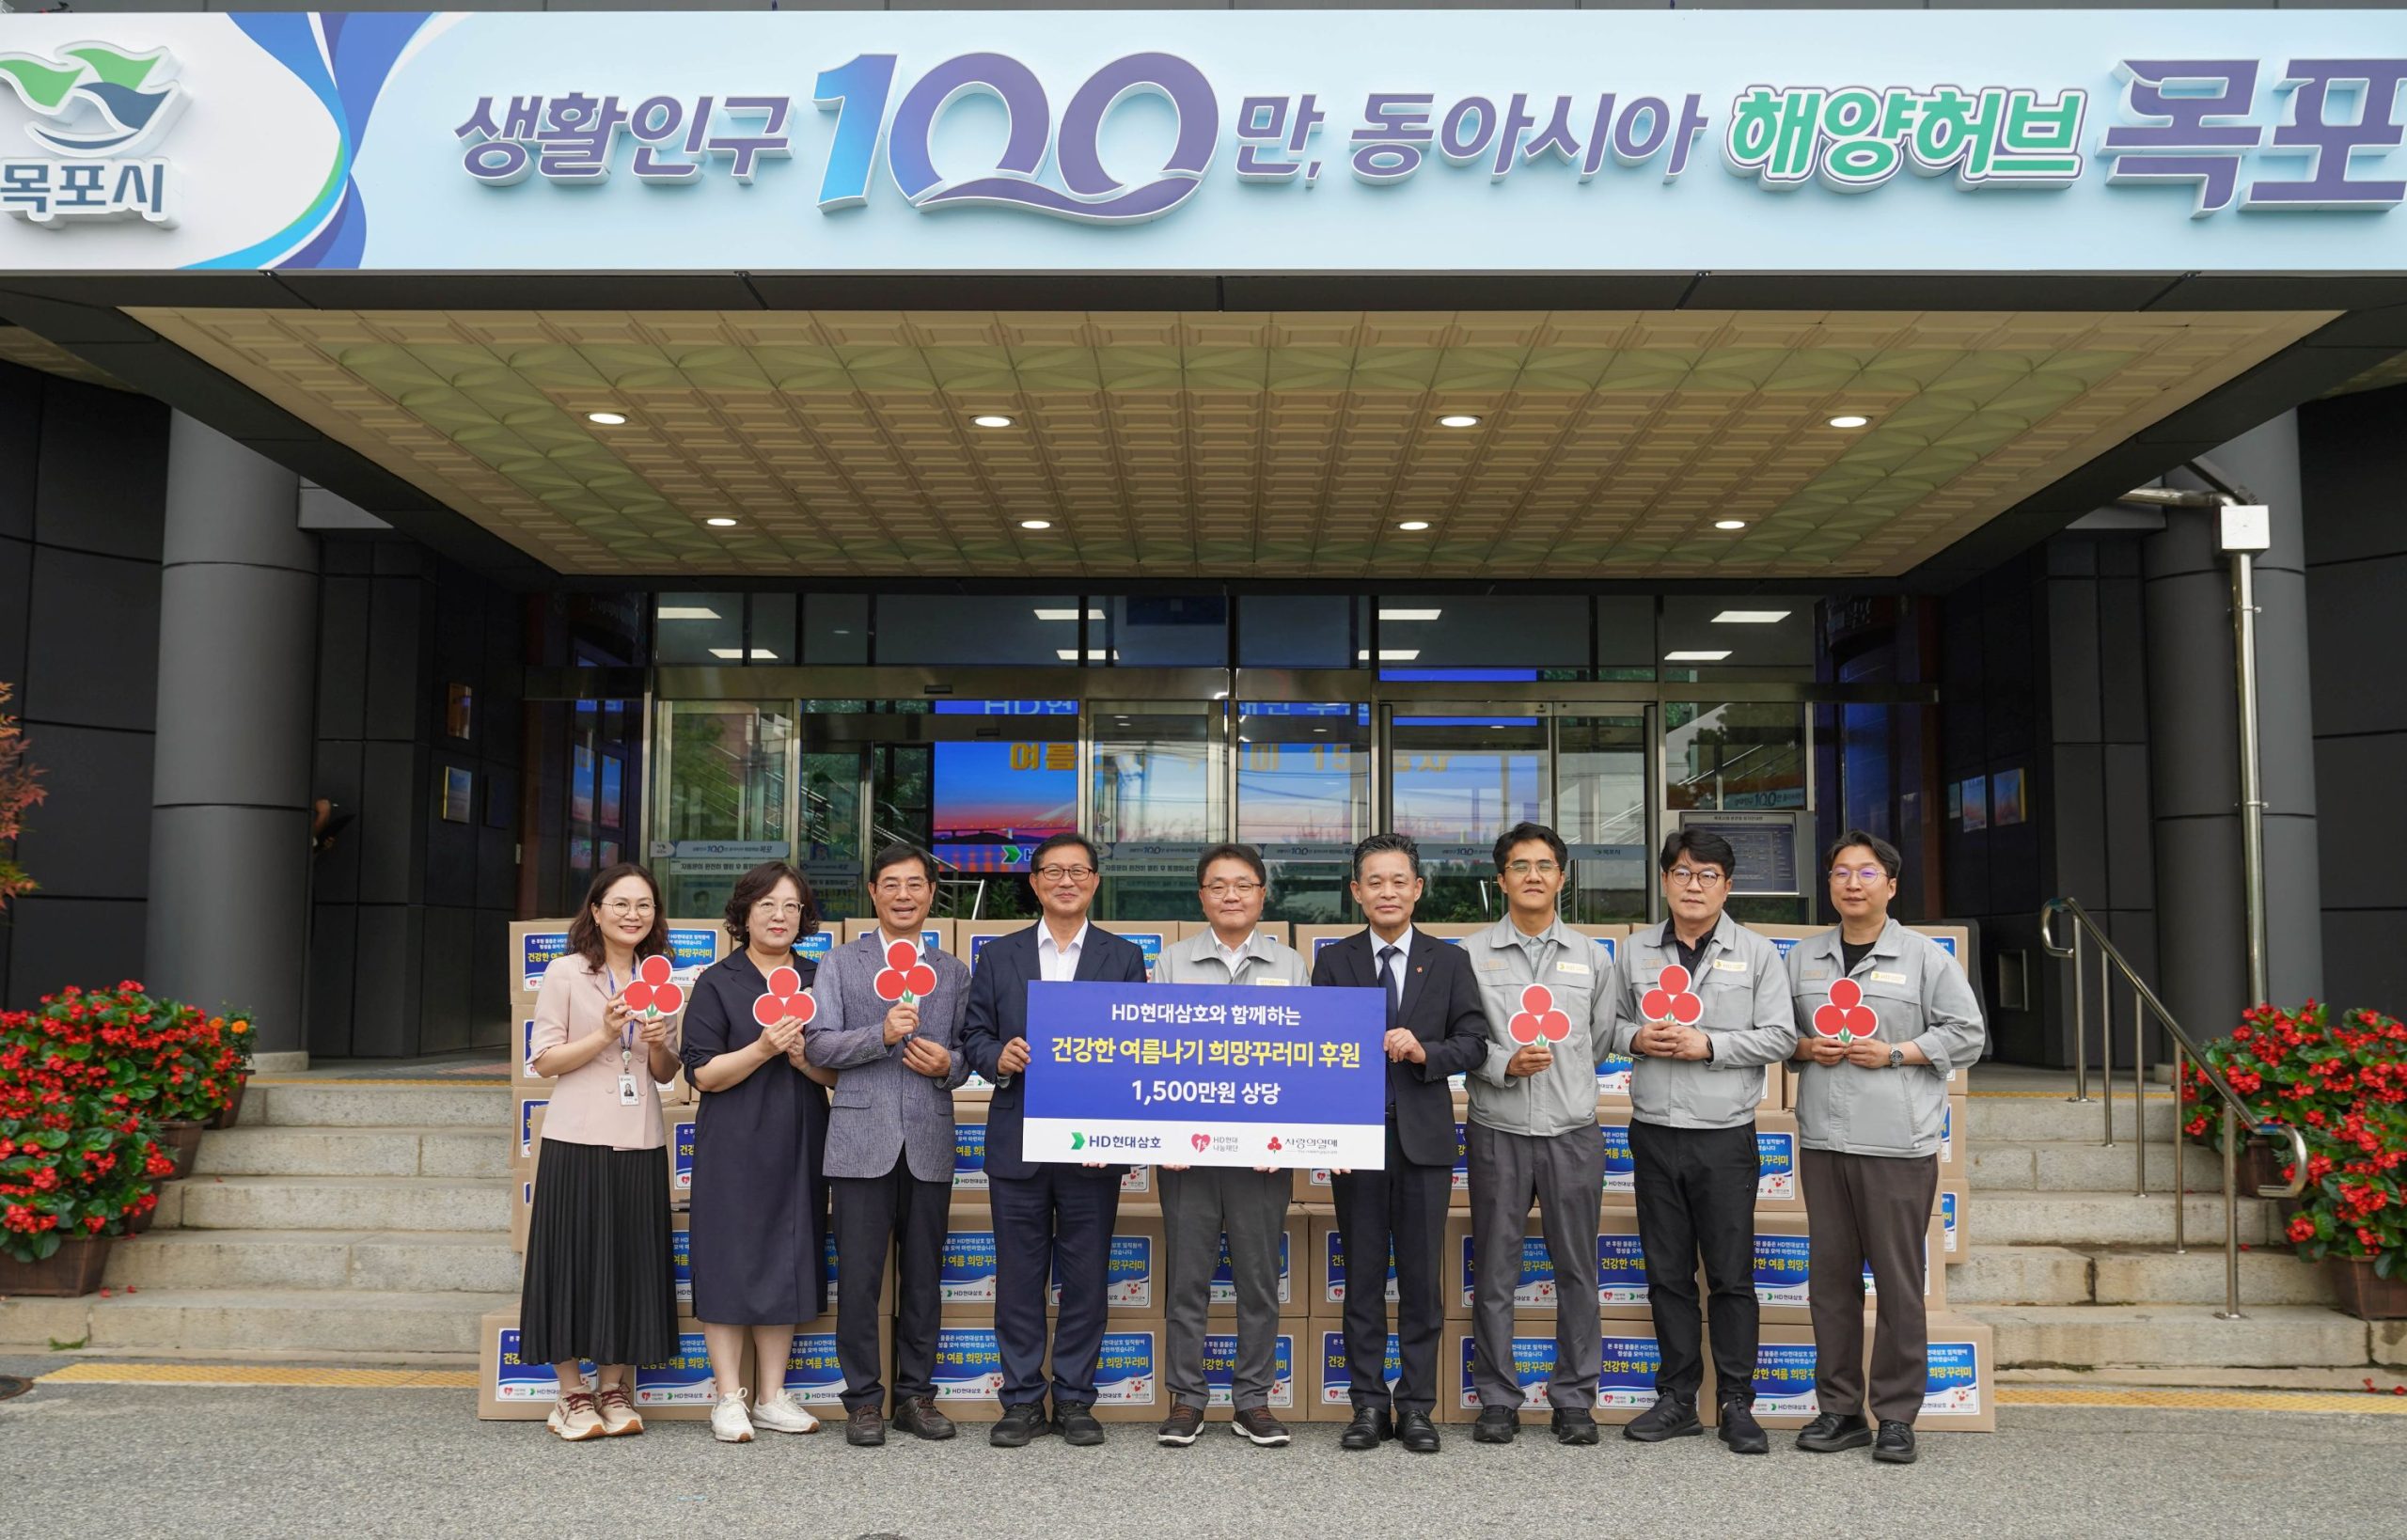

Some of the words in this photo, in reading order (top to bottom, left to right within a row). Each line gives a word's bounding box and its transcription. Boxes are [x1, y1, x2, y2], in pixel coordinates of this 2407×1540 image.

[455, 92, 793, 184] 생활인구
[1350, 92, 1708, 185] 동아시아
[1727, 84, 2088, 191] 해양허브
[2097, 58, 2407, 218] 목포
[2, 162, 166, 215] 목포시
[1010, 742, 1078, 771] 여름
[527, 952, 548, 962] 건강한
[678, 949, 712, 959] 희망꾸러미
[1111, 1003, 1226, 1025] HD현대삼호와
[1231, 1005, 1301, 1026] 함께하는
[1051, 1037, 1116, 1063] 건강한
[1120, 1039, 1204, 1065] 여름나기
[1208, 1041, 1314, 1067] 희망꾸러미
[1318, 1042, 1361, 1068] 후원
[1132, 1079, 1235, 1106] 1,500만원
[1241, 1082, 1281, 1105] 상당
[1089, 1135, 1161, 1150] HD현대삼호
[1285, 1139, 1337, 1149] 사랑의열매
[680, 1145, 694, 1155] 건강
[956, 1146, 972, 1156] 여름
[1605, 1148, 1619, 1159] 여름
[1759, 1155, 1788, 1166] 꾸러미
[949, 1256, 965, 1266] 여름
[968, 1255, 997, 1266] 희망꾸
[1109, 1260, 1145, 1272] 망꾸러미
[1602, 1258, 1628, 1270] 건강한
[1630, 1258, 1645, 1270] 여름
[1769, 1259, 1785, 1269] 여름
[1787, 1260, 1809, 1271] 희망꾸
[1523, 1261, 1553, 1272] 망꾸러
[504, 1353, 520, 1364] 건강
[669, 1358, 685, 1368] 여름
[688, 1357, 711, 1368] 희망꾸
[787, 1358, 804, 1369] 강한
[806, 1358, 822, 1369] 여름
[947, 1353, 964, 1364] 여름
[966, 1353, 1000, 1364] 희망꾸러
[1107, 1357, 1149, 1368] 희망꾸러미
[1329, 1356, 1346, 1368] 건강
[1603, 1360, 1629, 1373] 건강한
[1631, 1361, 1648, 1373] 여름
[1753, 1368, 1770, 1379] 강한
[1770, 1368, 1787, 1380] 여름
[1790, 1368, 1815, 1380] 희망꾸
[1929, 1367, 1973, 1378] 희망꾸러미
